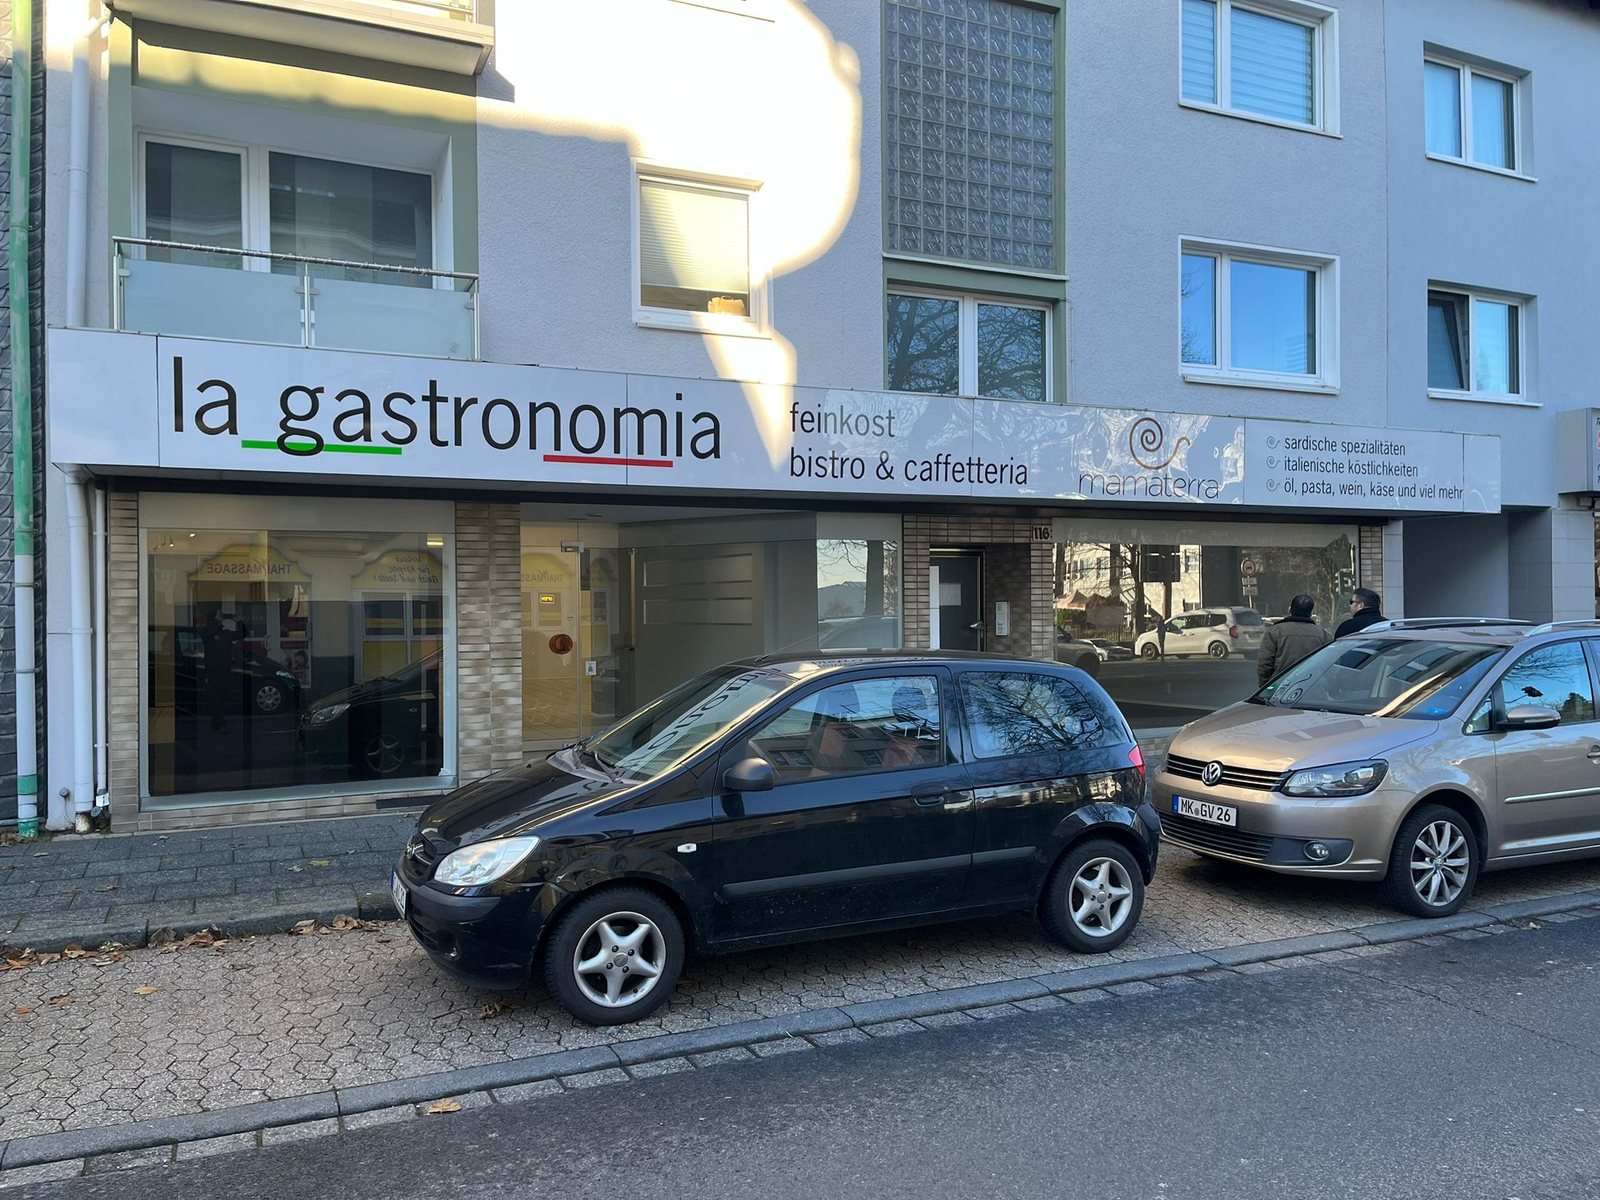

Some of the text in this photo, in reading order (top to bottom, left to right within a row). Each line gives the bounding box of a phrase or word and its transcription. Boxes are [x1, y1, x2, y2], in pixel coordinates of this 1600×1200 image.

[173, 356, 721, 459] la gastronomia
[790, 402, 895, 437] feinkost
[1284, 435, 1406, 456] sardische spezialitäten
[790, 447, 1028, 485] bistro & caffetteria
[1284, 456, 1418, 477] italienische köstlichkeiten
[1079, 473, 1219, 499] mamaterra
[1284, 478, 1463, 500] öl, pasta, wein, käse und viel mehr
[1181, 798, 1231, 822] MK GV 26
